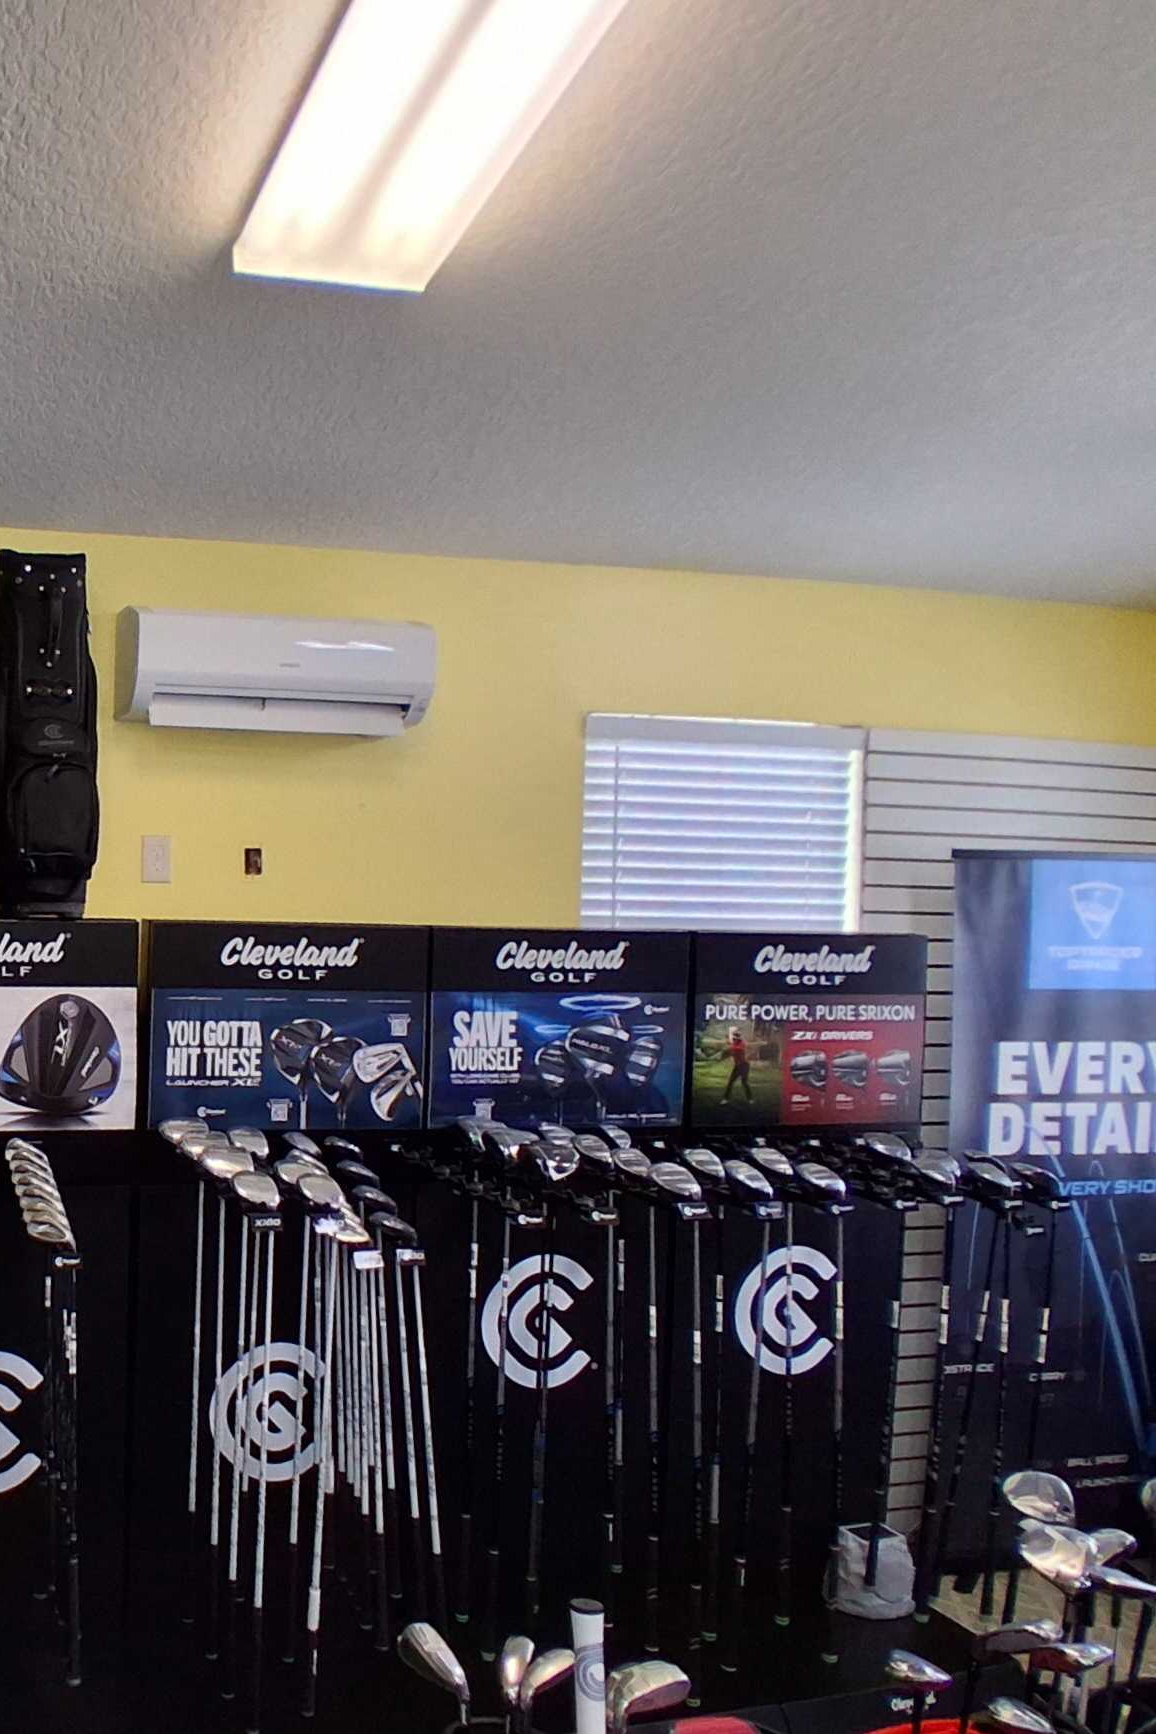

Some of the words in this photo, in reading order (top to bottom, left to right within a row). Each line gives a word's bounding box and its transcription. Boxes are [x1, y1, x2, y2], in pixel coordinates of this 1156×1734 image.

[220, 935, 360, 967] Cleveland
[495, 940, 625, 970] Cleveland
[754, 944, 872, 973] Cleveland
[257, 969, 328, 981] GOLF
[530, 972, 597, 983] GOLF
[785, 975, 847, 986] GOLF
[705, 1004, 748, 1021] PURE
[751, 1004, 814, 1023] POWER,
[816, 1004, 857, 1021] PURE
[859, 1004, 916, 1021] SRIXON
[166, 1021, 201, 1047] YOU
[202, 1021, 263, 1047] GOTTA
[452, 1010, 518, 1047] SAVE
[820, 1030, 874, 1041] DRIVERS
[165, 1047, 202, 1077] HIT
[202, 1048, 263, 1077] THESE
[448, 1047, 523, 1072] YOURSELF
